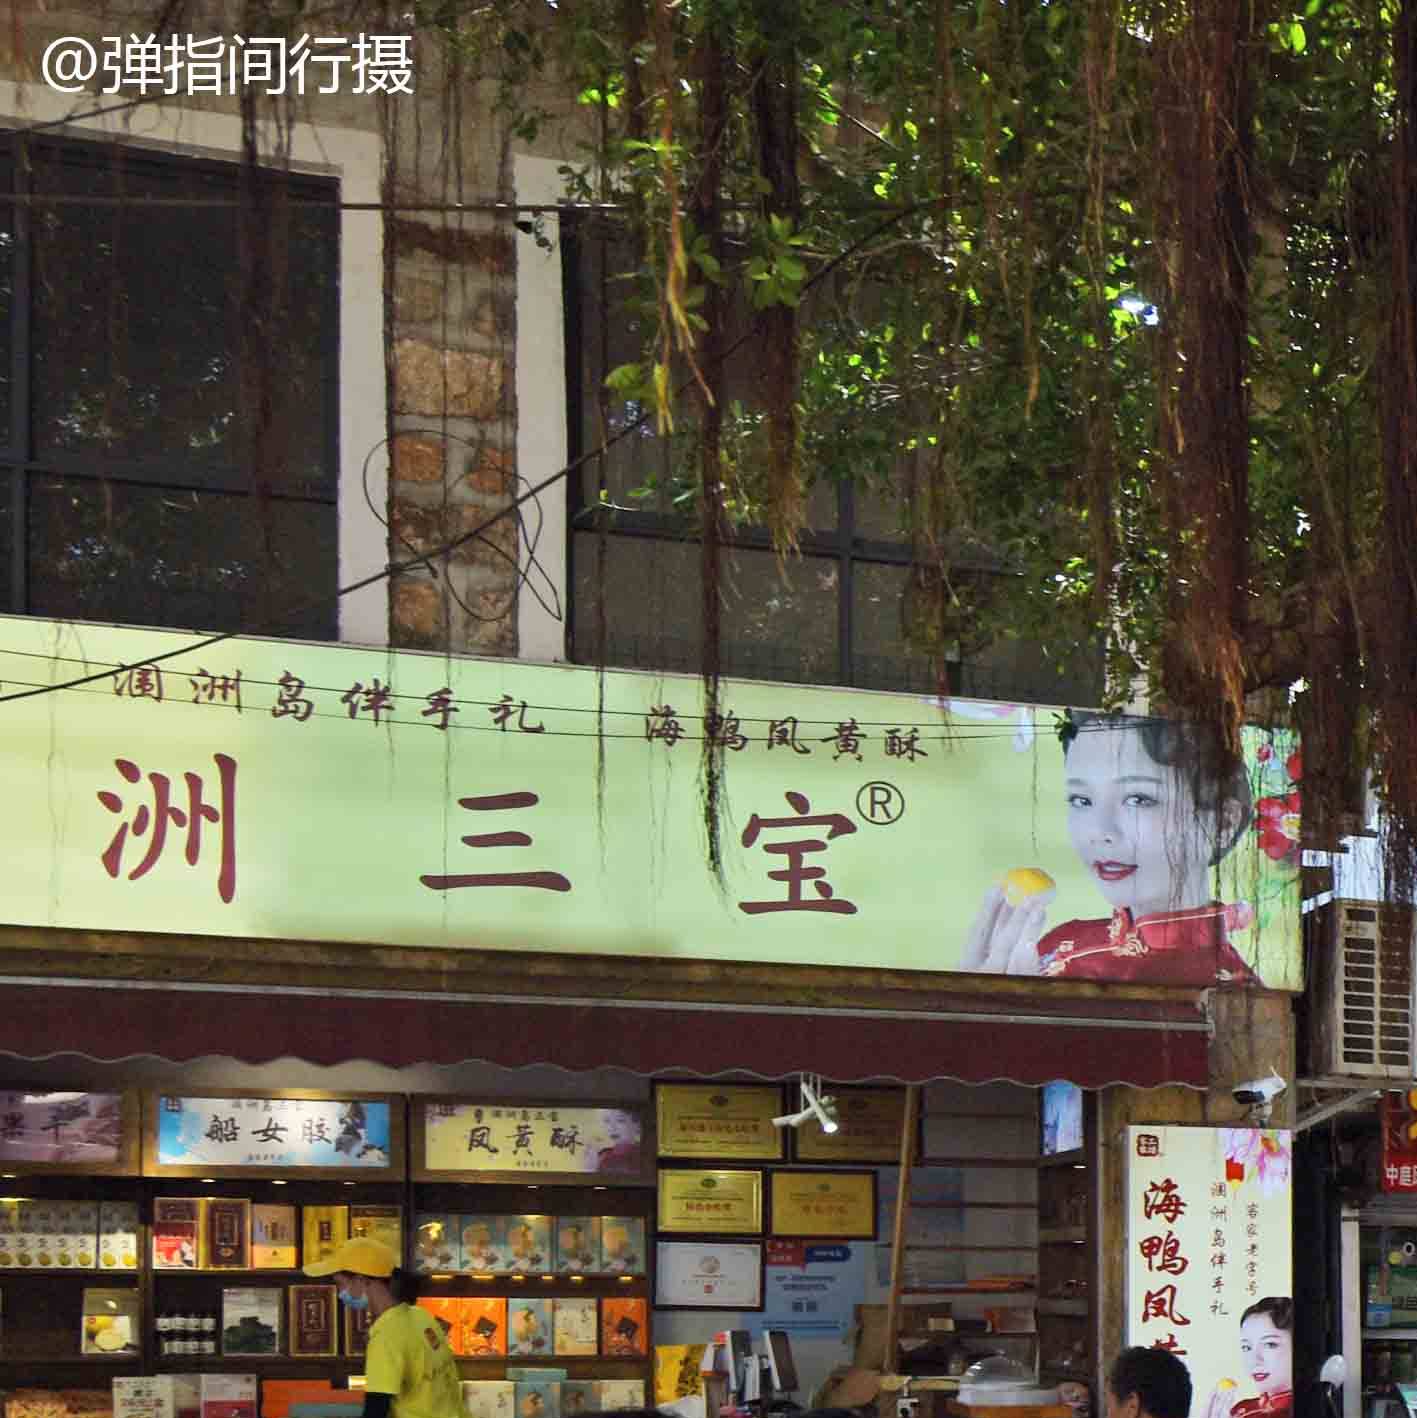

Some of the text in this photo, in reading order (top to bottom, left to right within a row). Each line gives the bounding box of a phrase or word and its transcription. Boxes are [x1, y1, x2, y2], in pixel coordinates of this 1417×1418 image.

[113, 661, 544, 733] 涠洲岛伴手礼
[204, 1115, 334, 1145] 船女胶
[468, 1125, 584, 1155] 凤黄酥
[1209, 1181, 1228, 1317] 涠洲岛伴手礼
